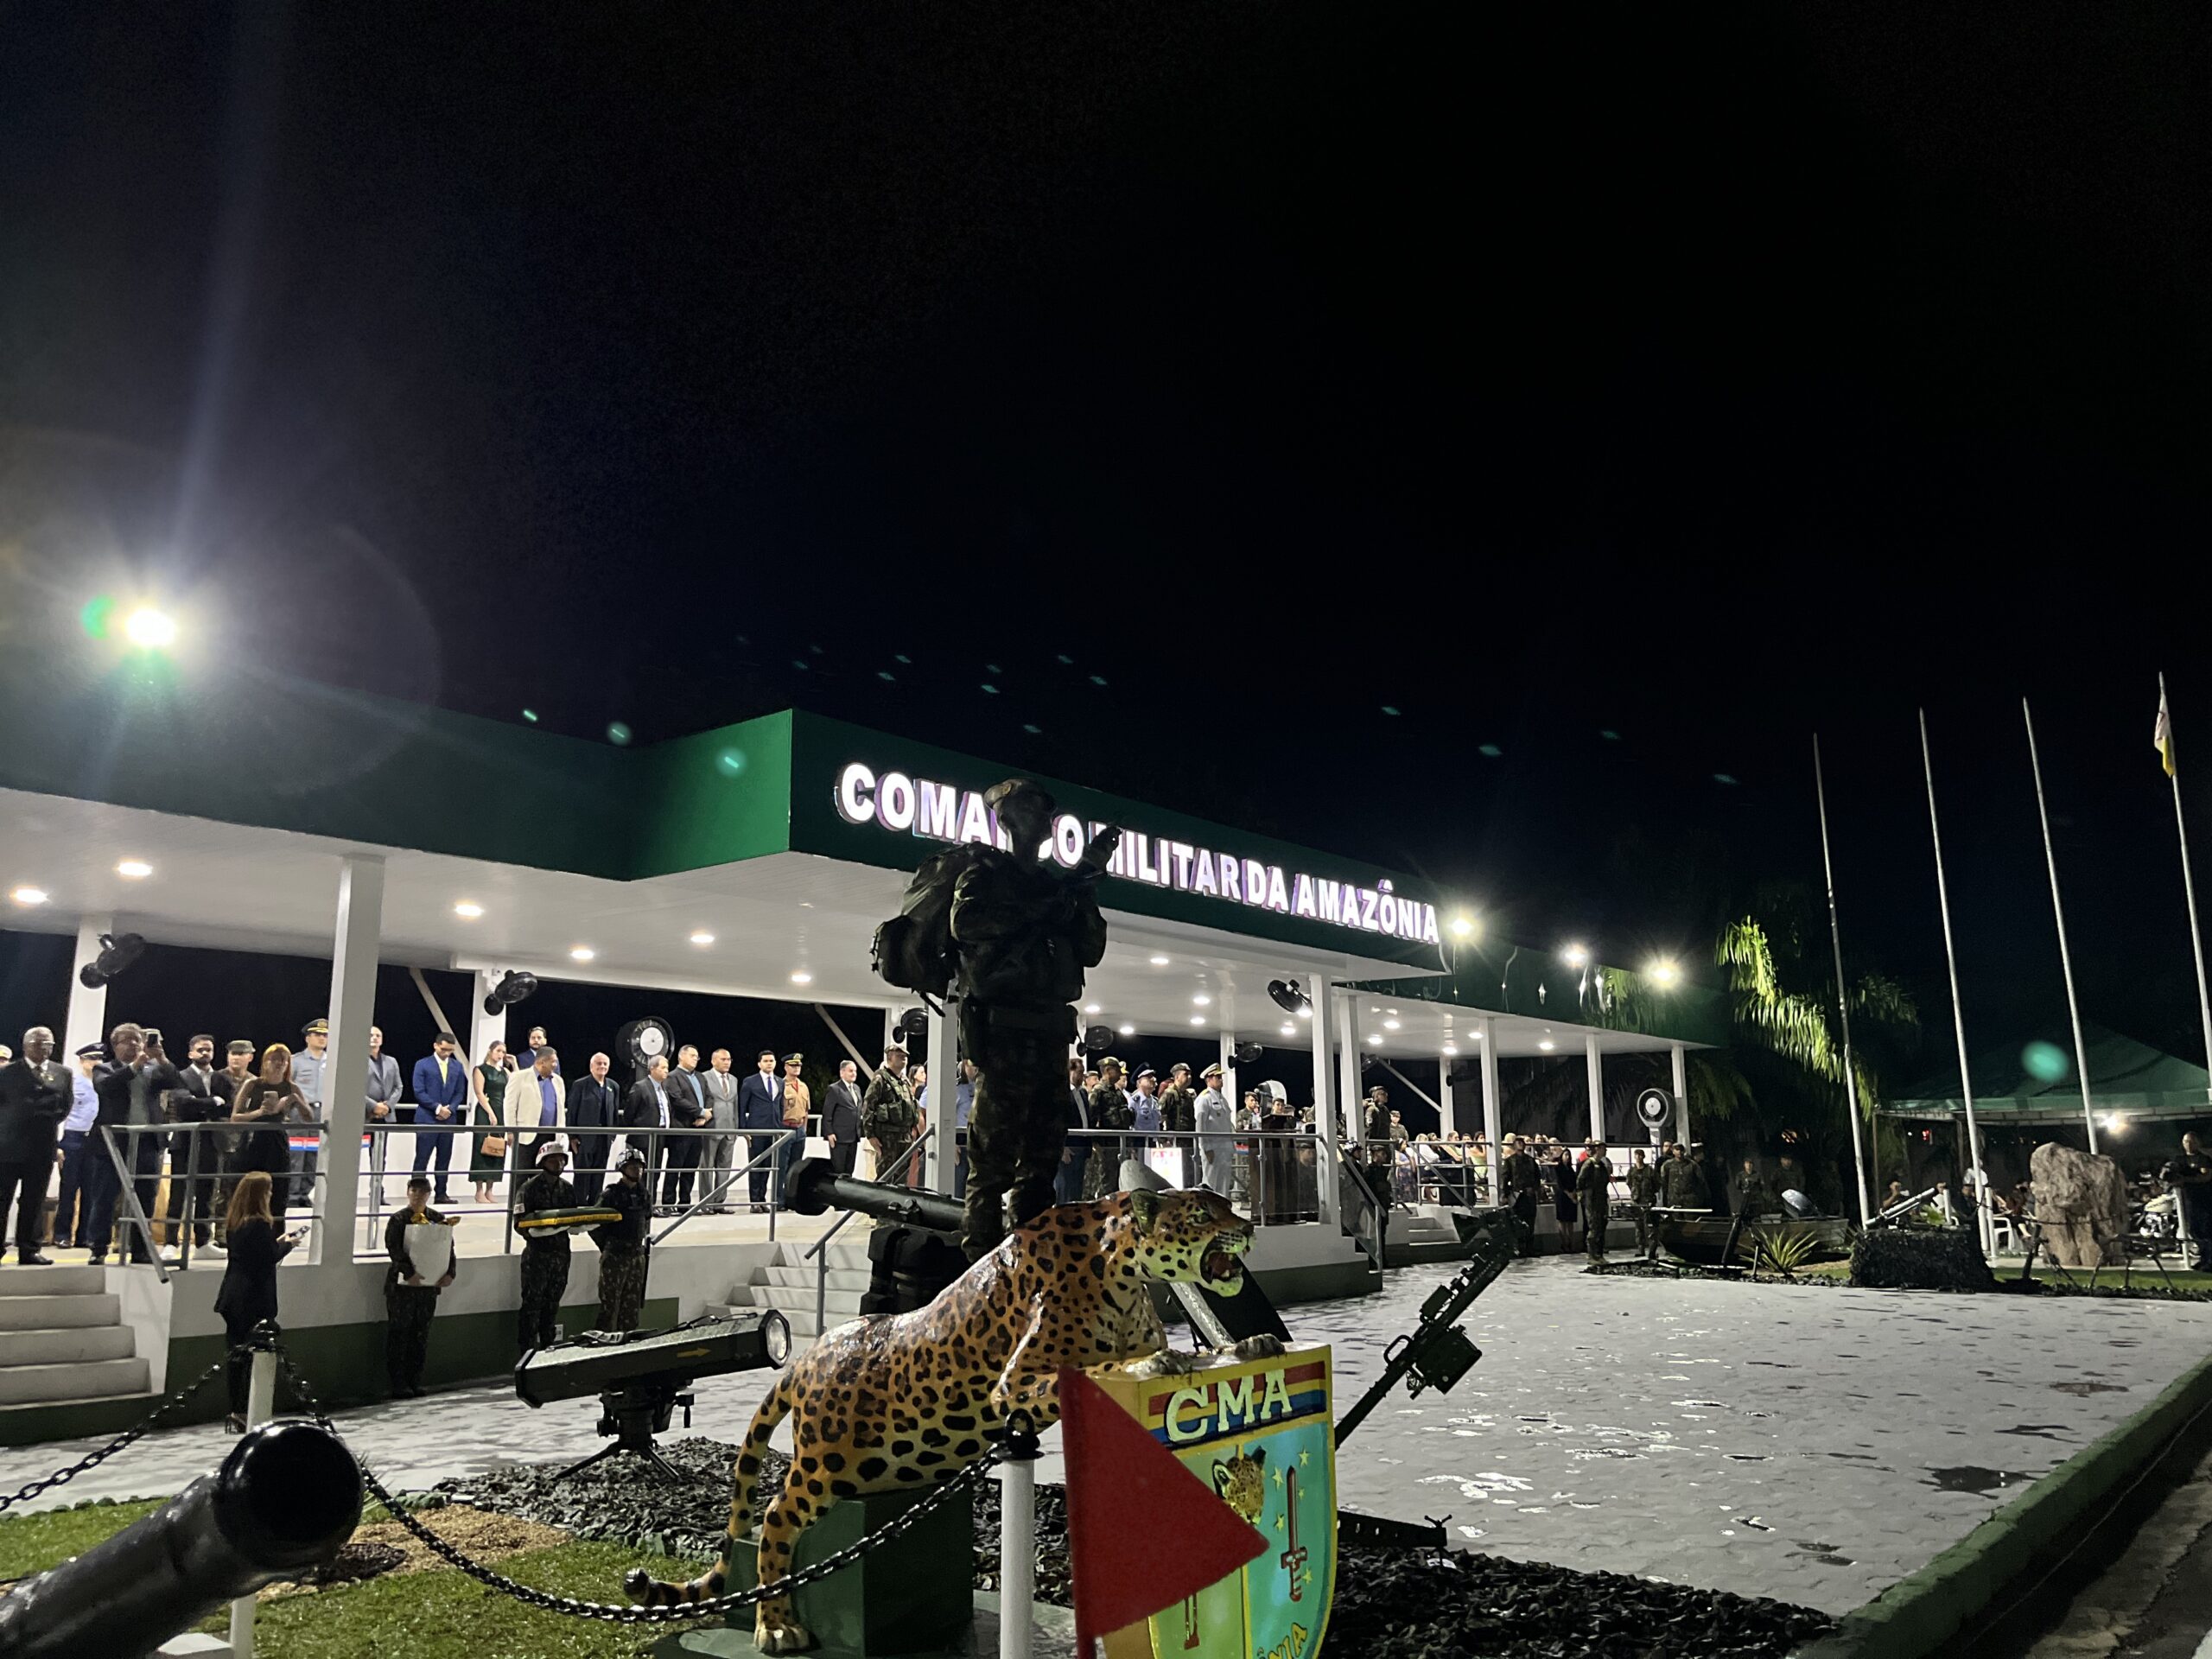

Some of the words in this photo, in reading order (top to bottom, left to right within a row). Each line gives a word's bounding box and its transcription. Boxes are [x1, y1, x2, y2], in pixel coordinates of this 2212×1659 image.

[836, 763, 1084, 869] COMAO
[1242, 858, 1289, 914] DA
[1291, 873, 1440, 944] AMAZÔNIA
[1166, 1368, 1293, 1442] CMA
